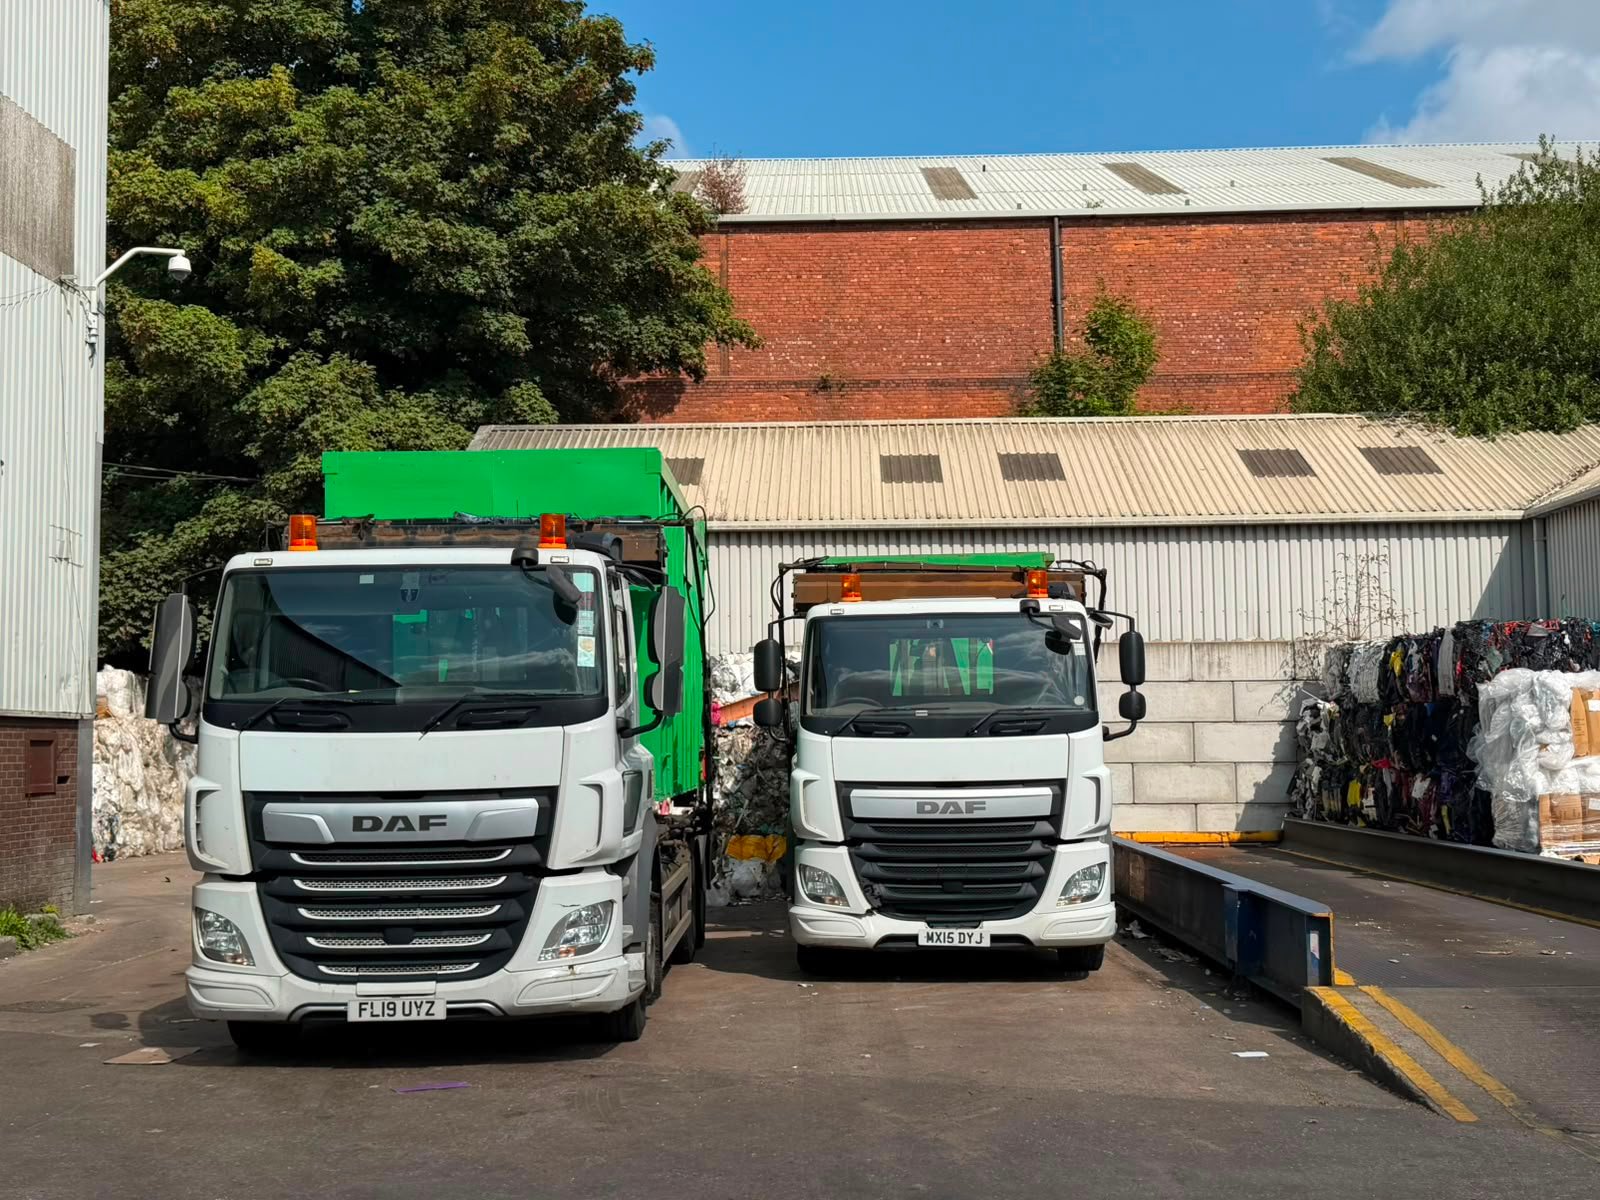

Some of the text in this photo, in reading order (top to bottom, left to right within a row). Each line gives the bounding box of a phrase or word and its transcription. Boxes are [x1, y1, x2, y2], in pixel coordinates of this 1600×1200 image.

[916, 800, 987, 815] DAF
[352, 814, 448, 833] DAF
[926, 931, 983, 945] MX15 DYJ
[358, 1000, 436, 1018] FL19 UYZ
